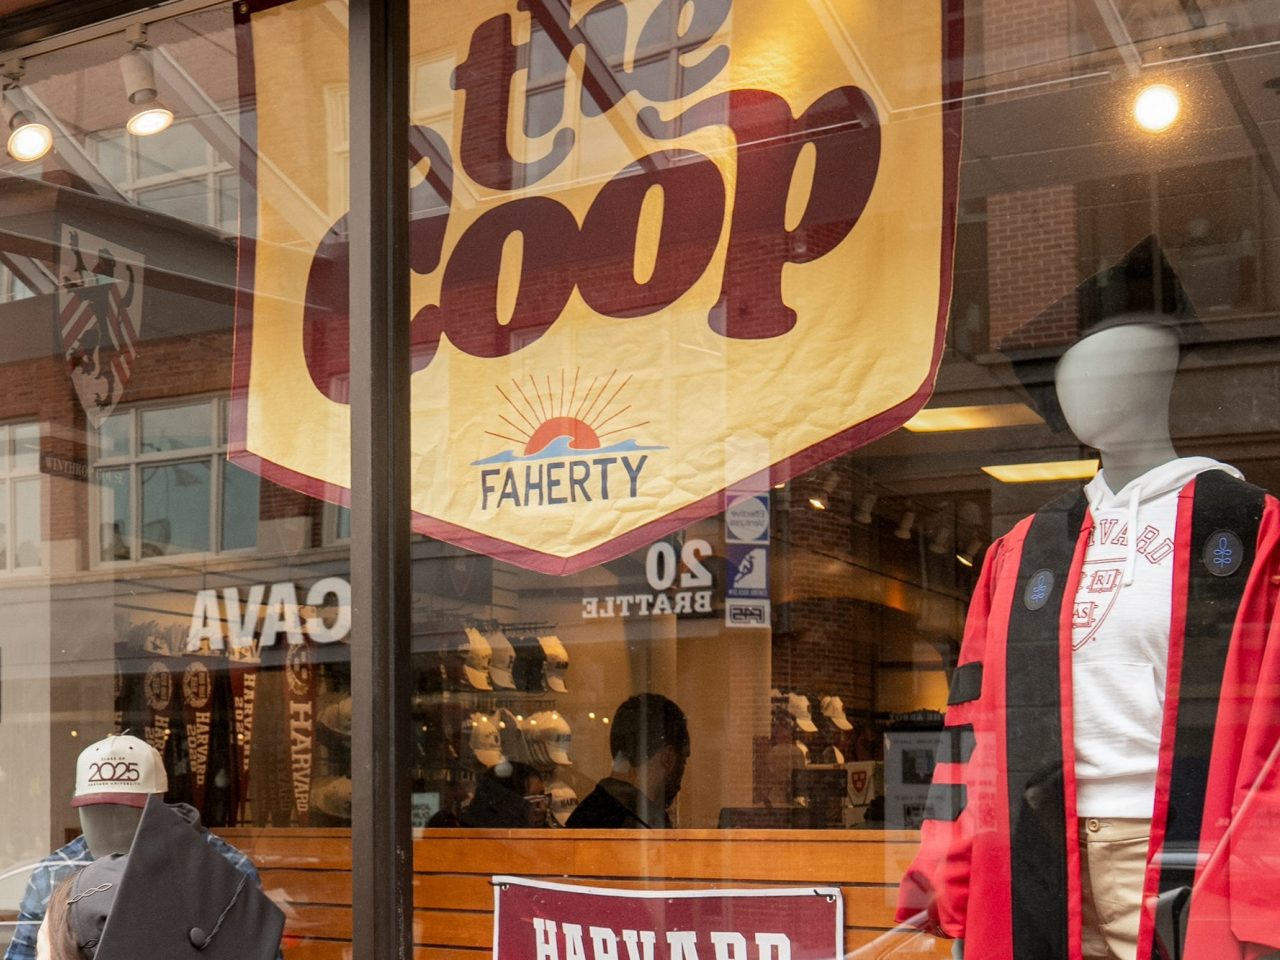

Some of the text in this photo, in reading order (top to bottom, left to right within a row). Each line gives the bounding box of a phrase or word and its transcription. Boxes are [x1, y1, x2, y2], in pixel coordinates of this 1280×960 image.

[449, 0, 732, 191] the
[480, 454, 649, 511] FAHERTY
[1088, 519, 1175, 565] VARD
[195, 711, 211, 785] HARVARD
[243, 673, 256, 771] HARVARD
[289, 700, 313, 813] HARVARD
[88, 761, 140, 782] 2025
